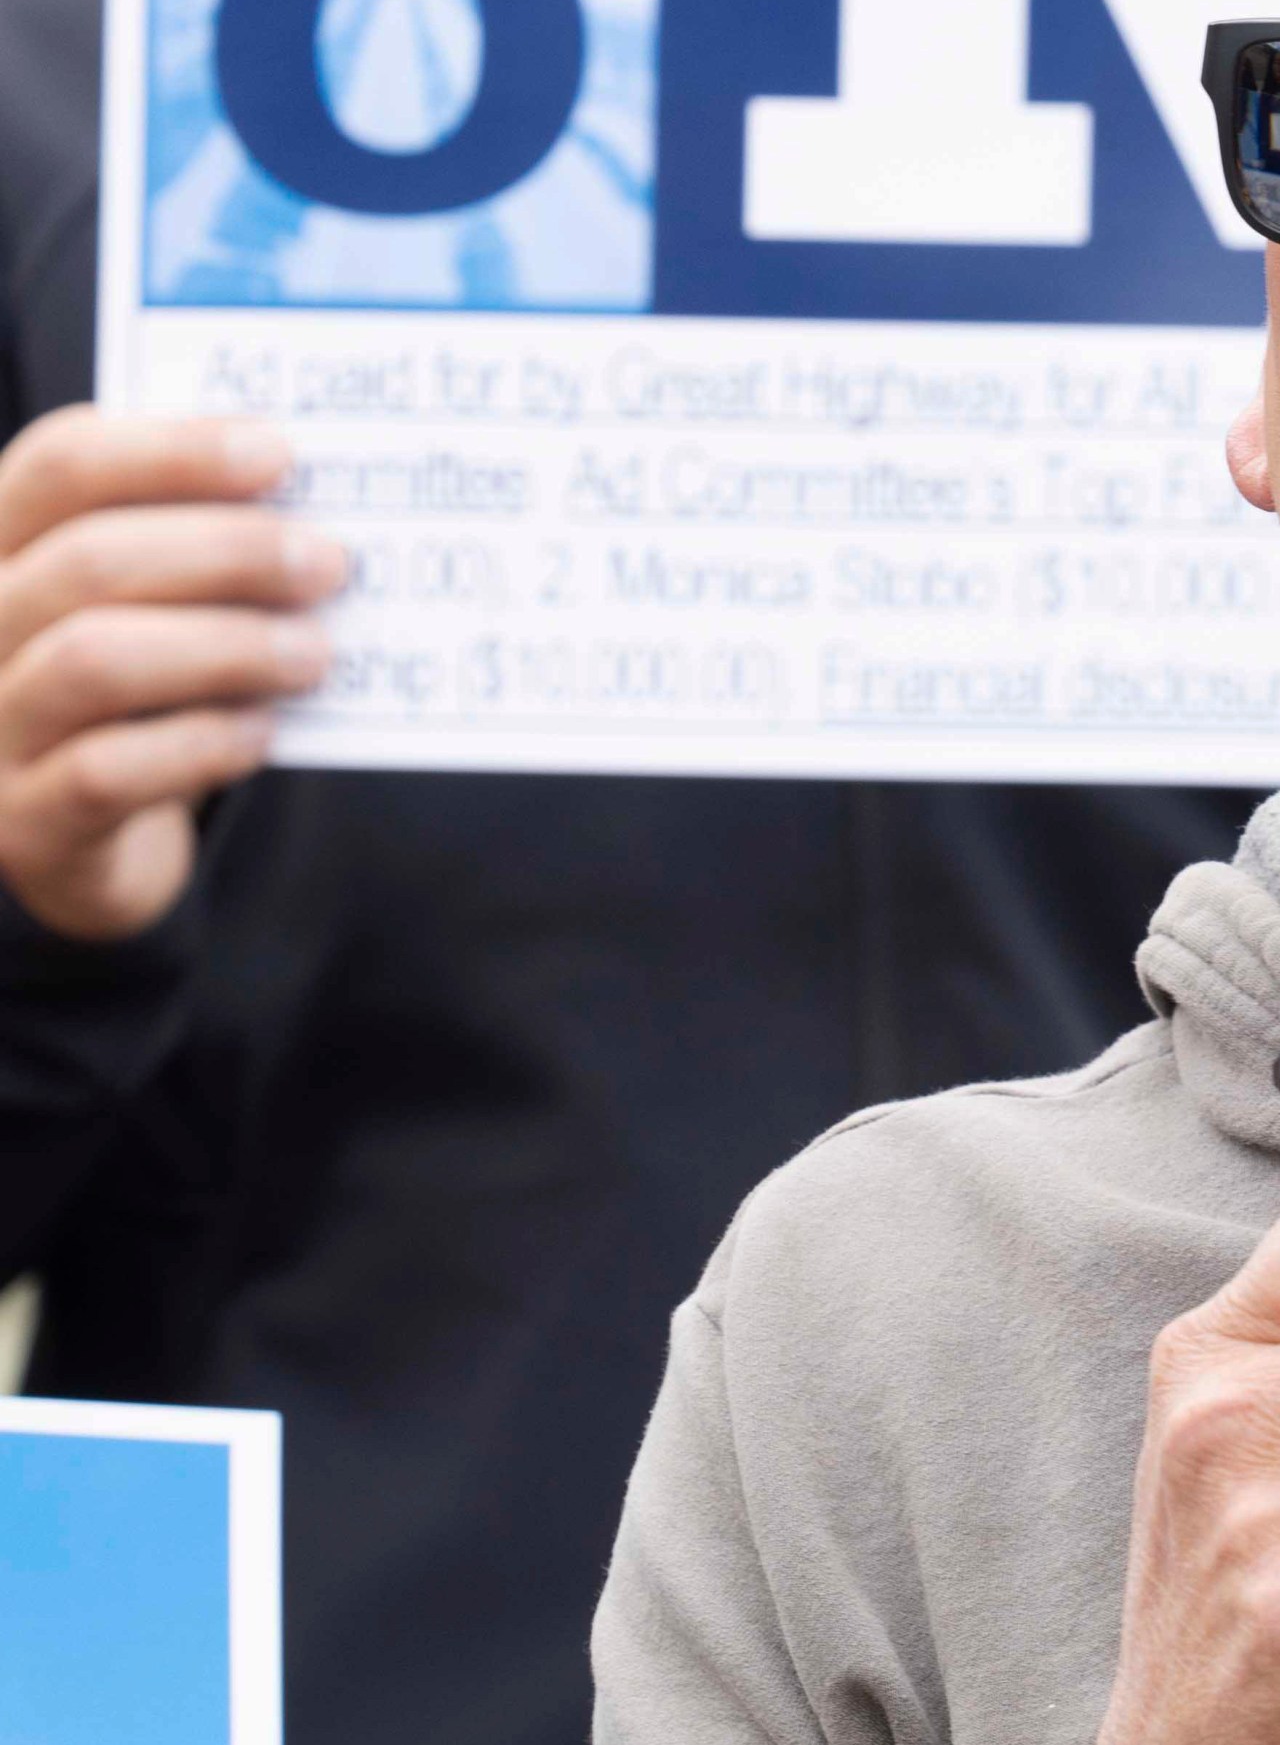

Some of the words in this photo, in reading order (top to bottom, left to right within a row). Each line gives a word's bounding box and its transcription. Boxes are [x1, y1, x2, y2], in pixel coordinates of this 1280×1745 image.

[198, 346, 278, 412] Ad
[294, 350, 412, 426] paid
[434, 348, 503, 416] for
[519, 352, 587, 430] by
[605, 342, 768, 419] Great
[783, 350, 1024, 436] Highway
[1045, 358, 1118, 432] for
[565, 446, 642, 520] Ad
[604, 542, 813, 612] Monica
